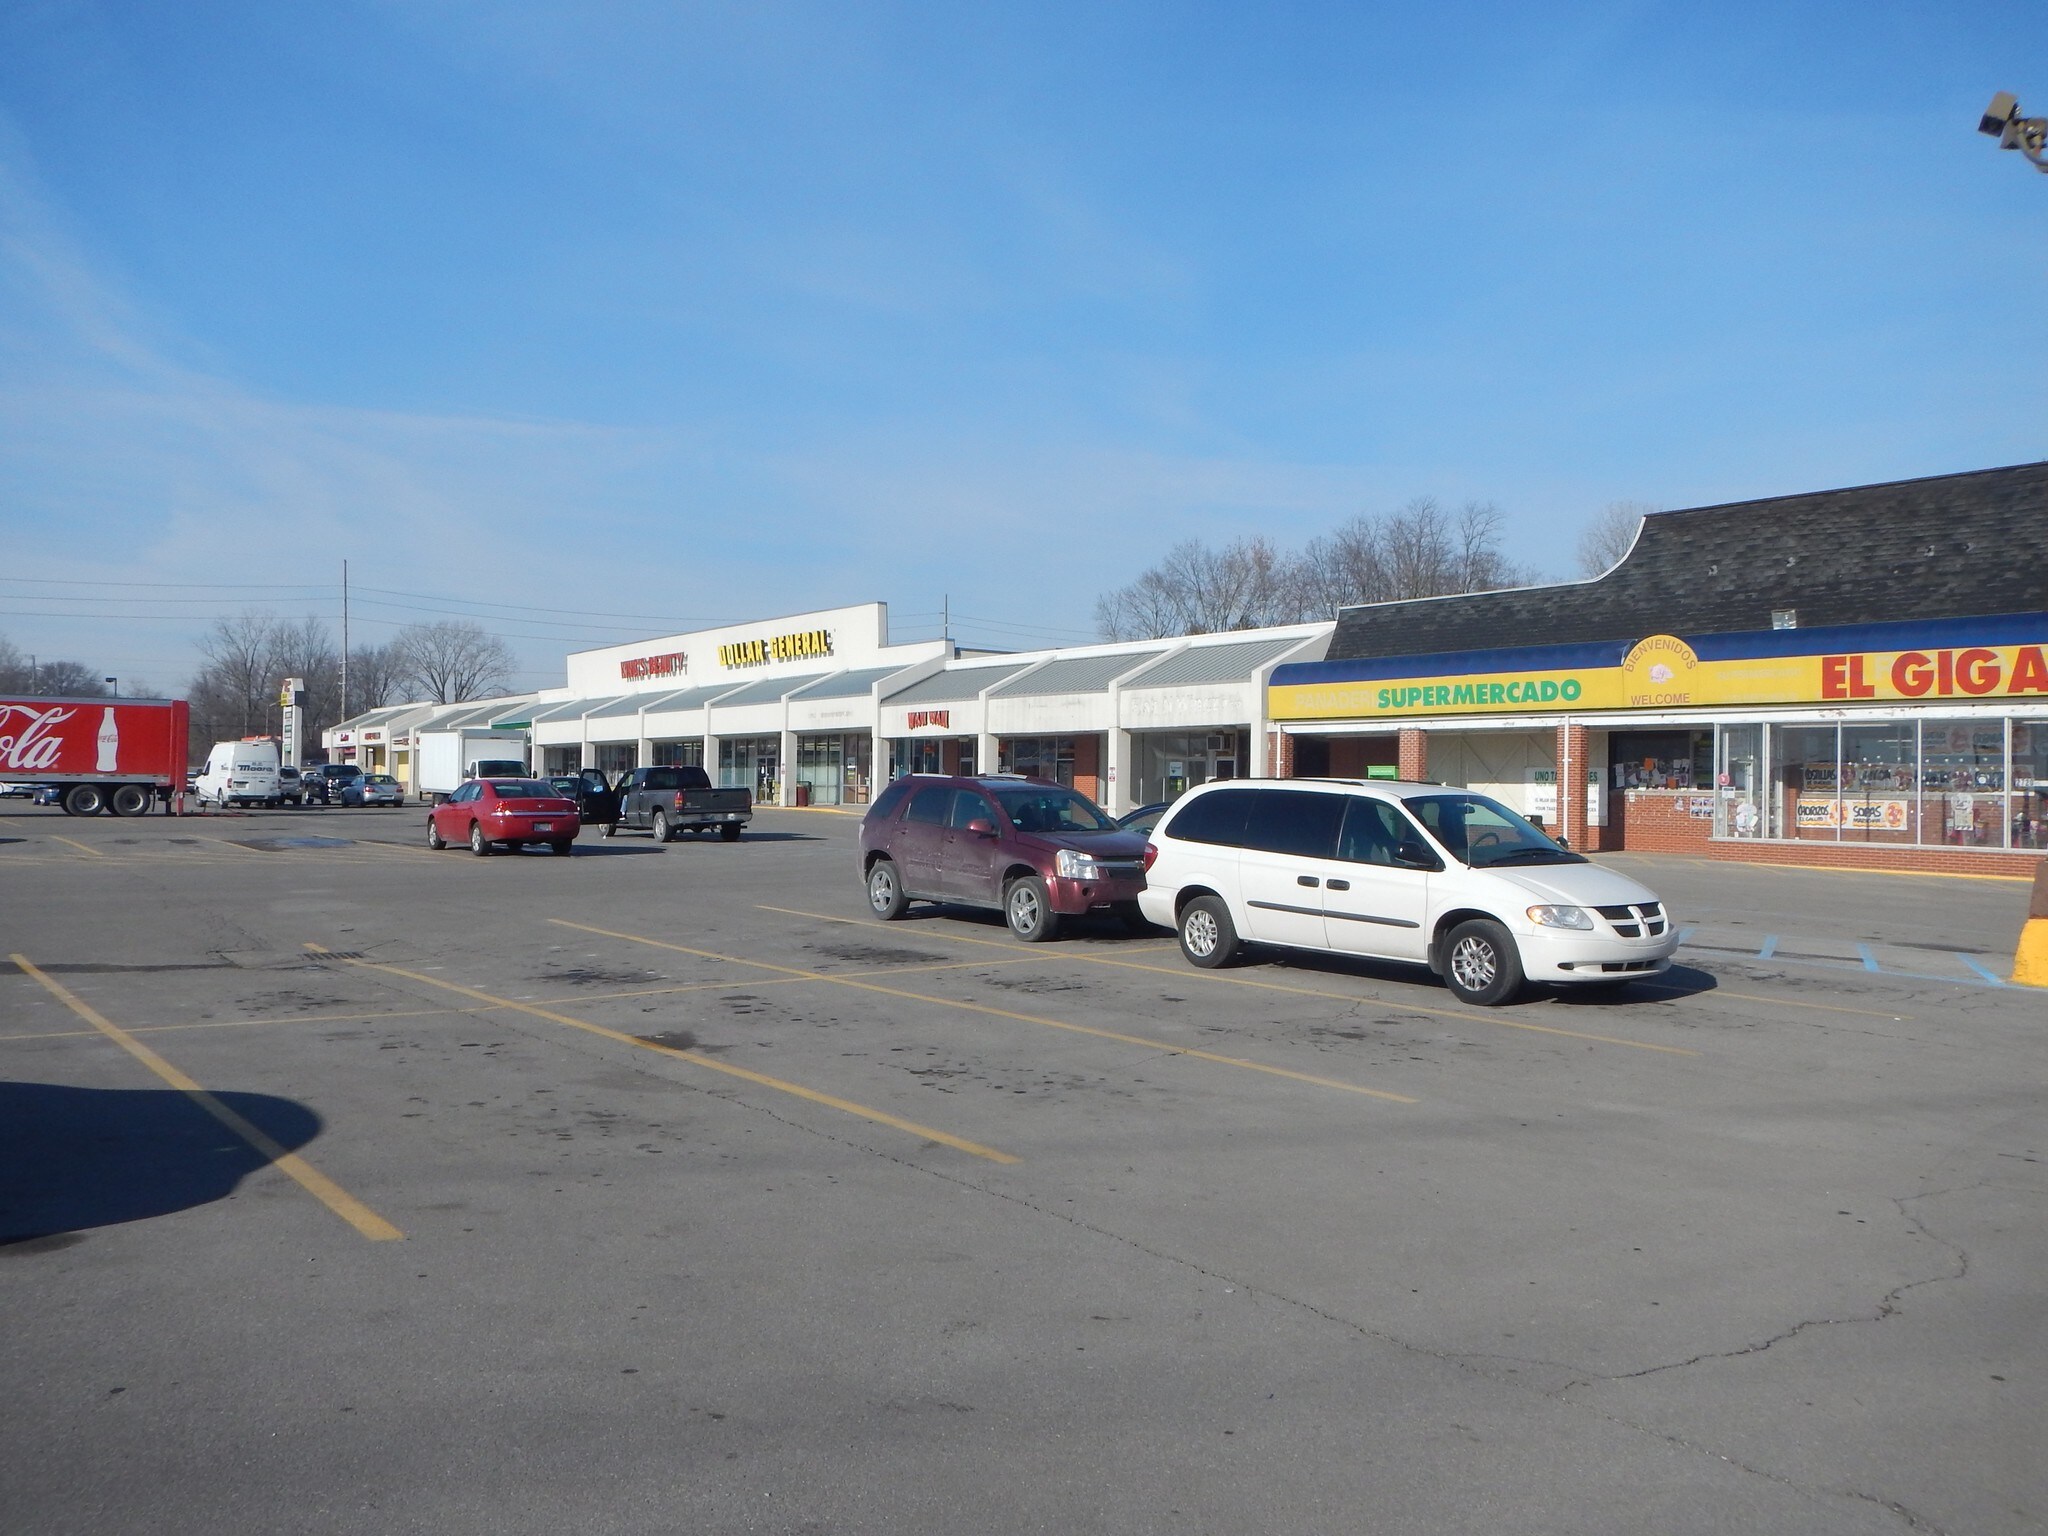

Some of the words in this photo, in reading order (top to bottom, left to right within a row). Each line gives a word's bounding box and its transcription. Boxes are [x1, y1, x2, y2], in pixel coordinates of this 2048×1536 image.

[718, 639, 768, 667] DOLLAR
[769, 629, 829, 659] GENERAL
[1625, 639, 1696, 672] BIENVENIDOS
[1822, 656, 1875, 699] EL
[1891, 647, 2048, 697] GIGA
[1378, 679, 1581, 708] SUPERMERCADO
[1631, 693, 1690, 706] WELCOME
